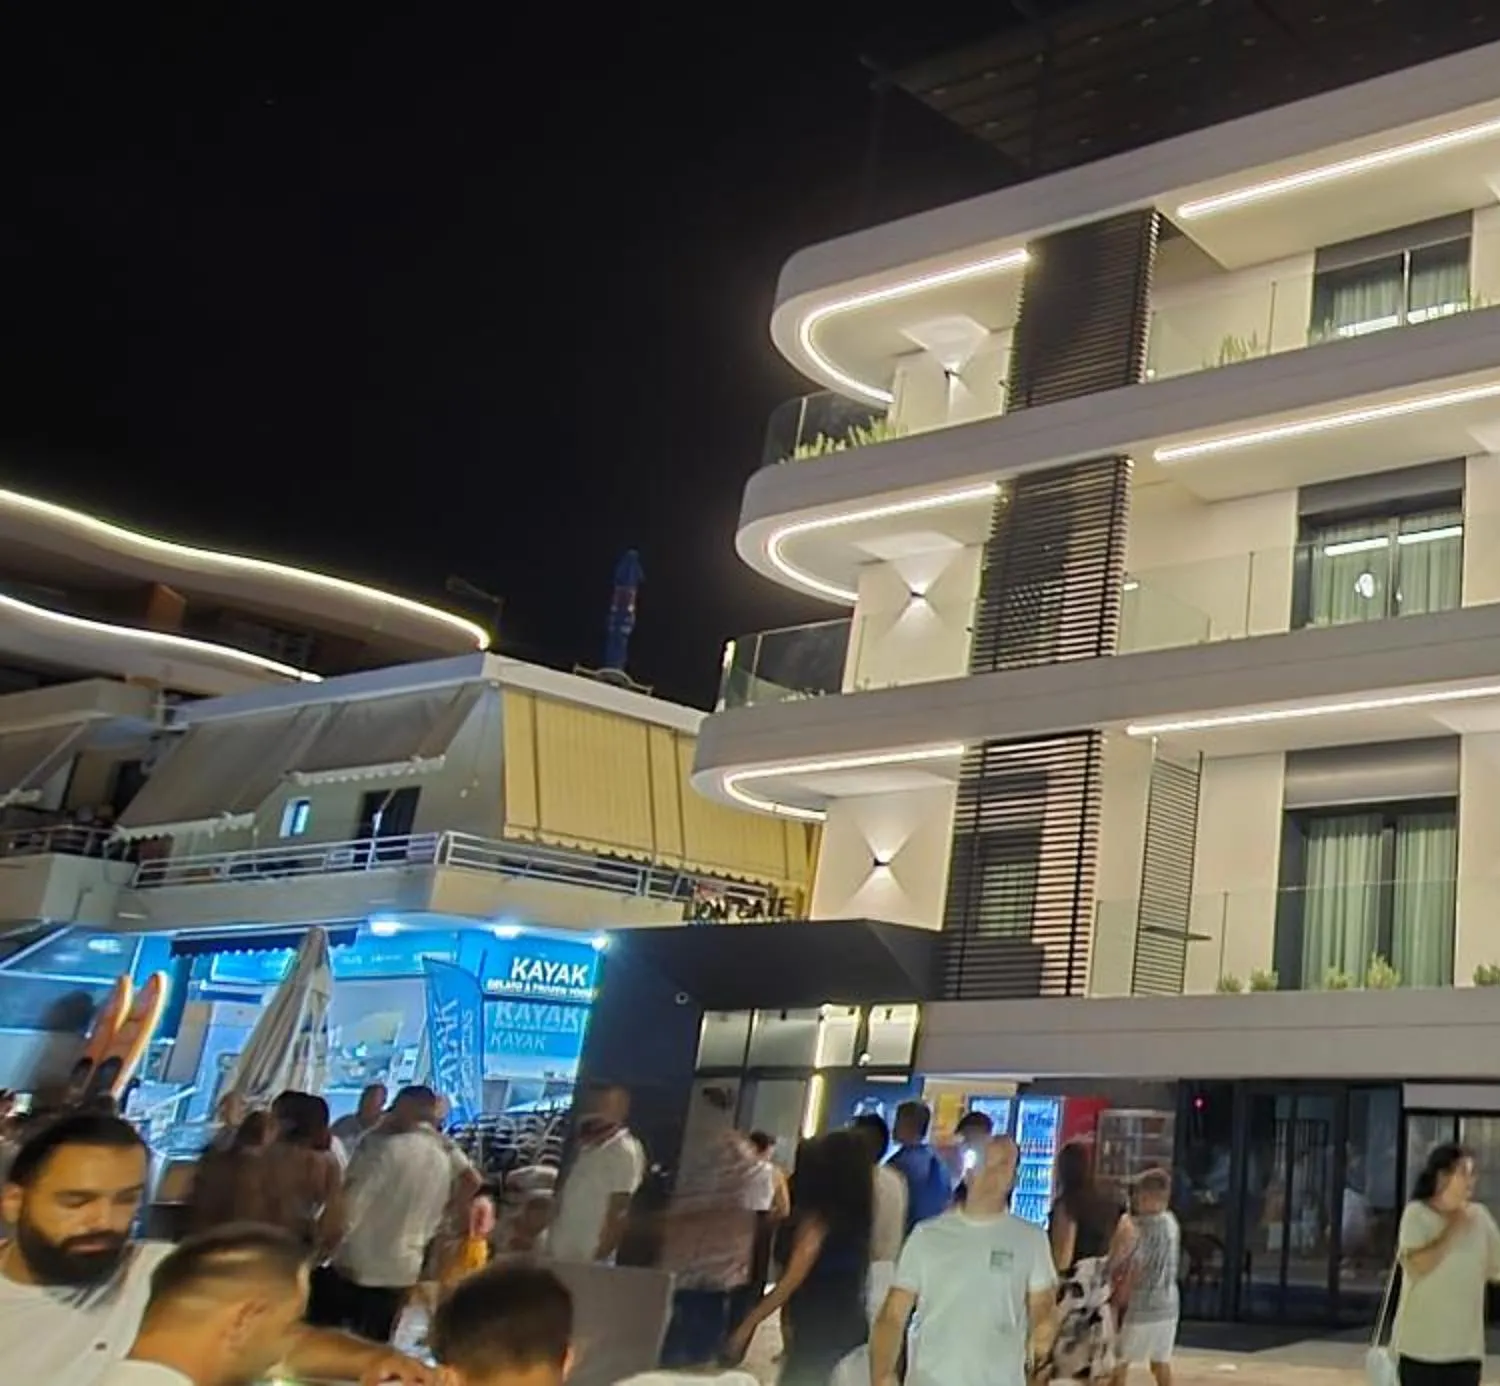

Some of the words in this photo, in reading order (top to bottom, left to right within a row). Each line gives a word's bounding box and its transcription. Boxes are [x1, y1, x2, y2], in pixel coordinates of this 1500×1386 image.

[511, 956, 589, 986] KAYAK
[496, 1002, 579, 1024] KAYAK
[491, 1031, 546, 1051] KAYAK
